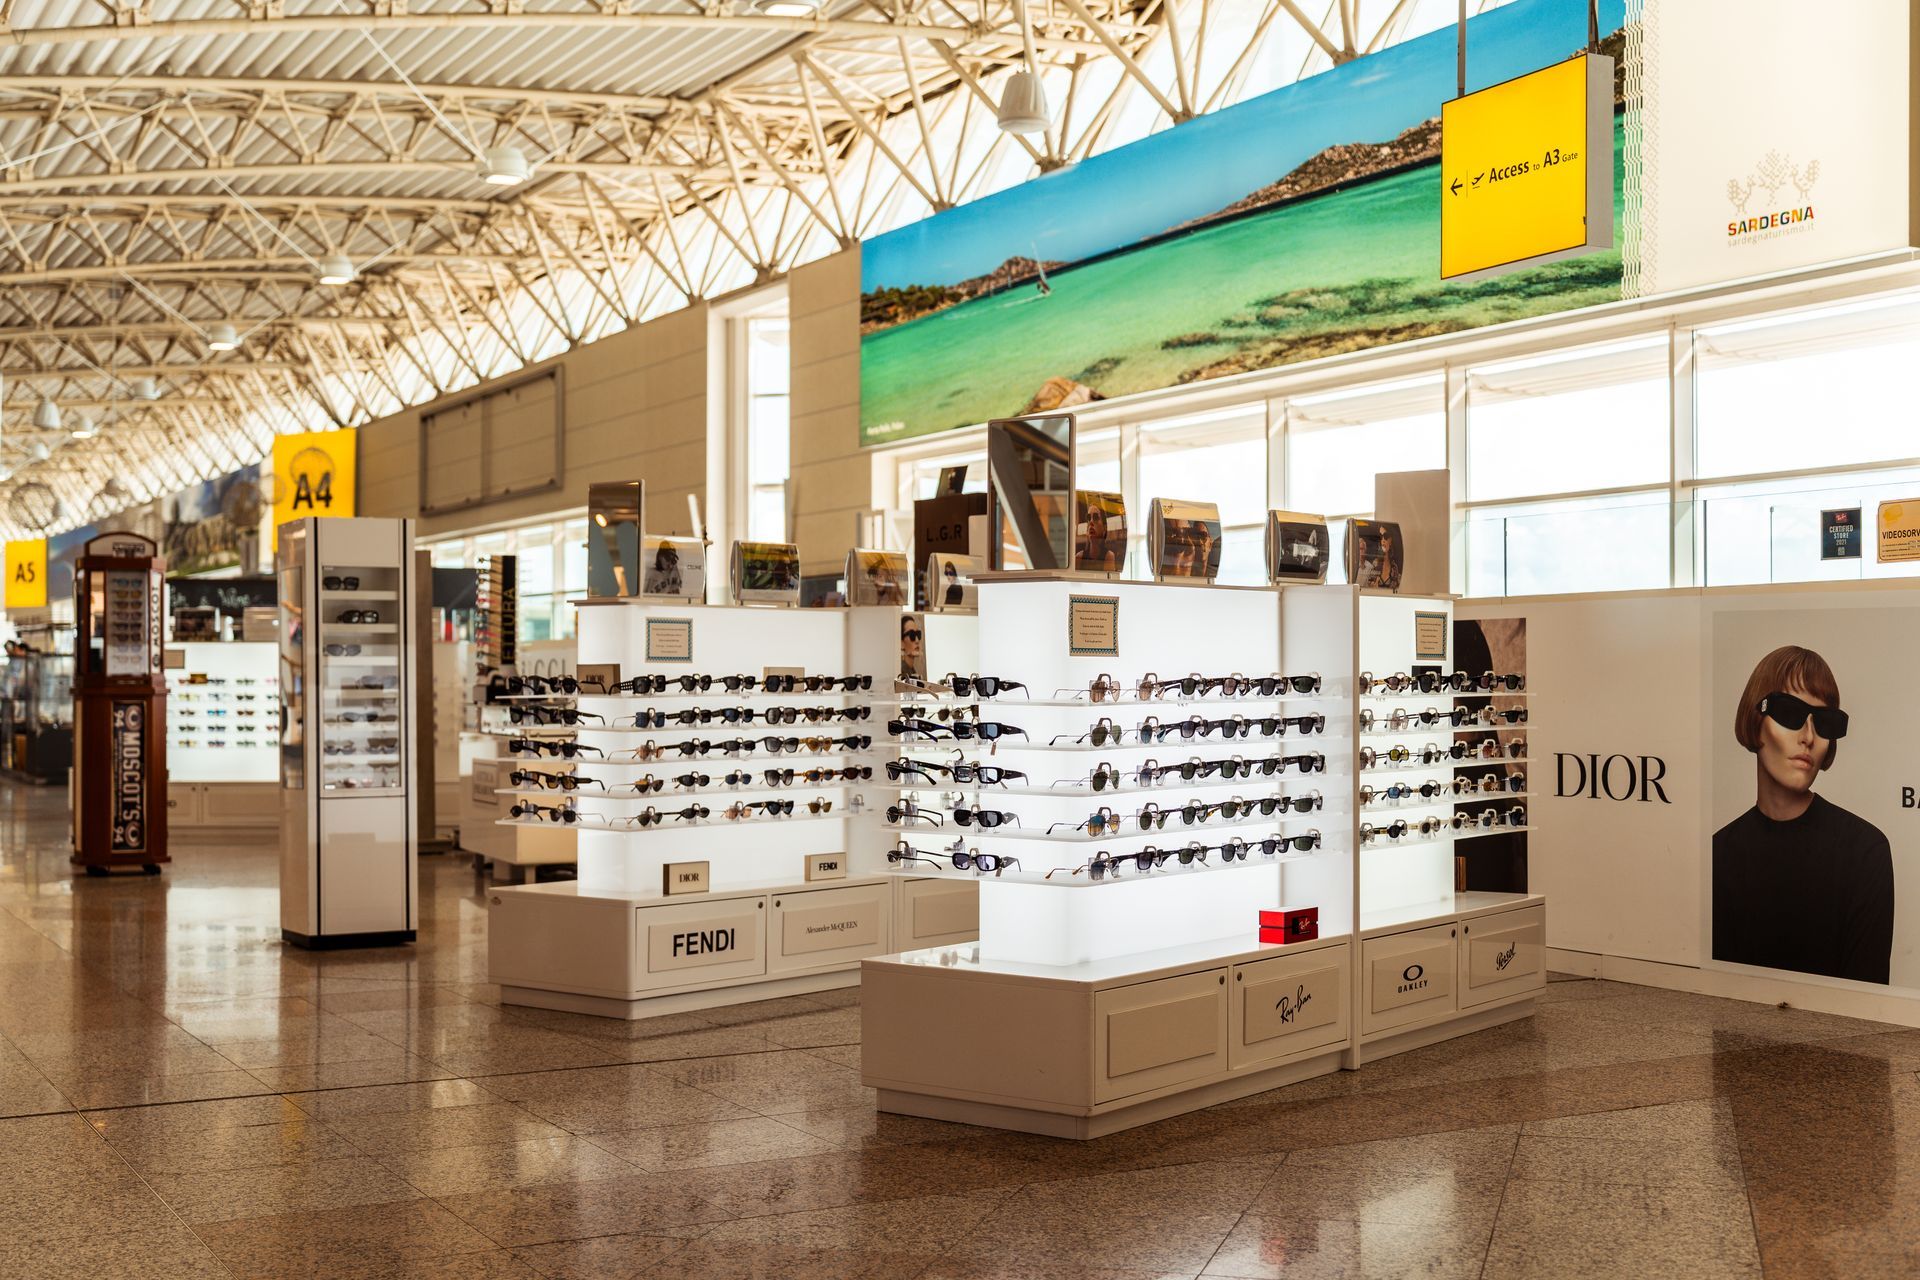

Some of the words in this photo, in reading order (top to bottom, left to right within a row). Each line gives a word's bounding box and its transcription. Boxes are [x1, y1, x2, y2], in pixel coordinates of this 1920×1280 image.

[1489, 161, 1530, 183] Access
[1533, 162, 1541, 171] to
[1543, 148, 1560, 168] A3
[1561, 151, 1579, 163] Gate
[1727, 206, 1815, 236] SARDEGNA
[1727, 222, 1815, 248] sardegnaturismo.it
[292, 471, 333, 510] A4
[926, 524, 962, 542] L.G.R
[1829, 525, 1853, 533] CERTIFIED
[1833, 532, 1849, 540] STORE
[15, 561, 35, 583] A5
[123, 732, 141, 821] MOSCOT'S
[1553, 752, 1672, 804] DIOR
[679, 873, 700, 883] DIOR
[818, 862, 838, 871] FENDI
[673, 928, 735, 957] FENDI
[1496, 941, 1516, 970] Persol
[1397, 980, 1429, 994] OAKLEY
